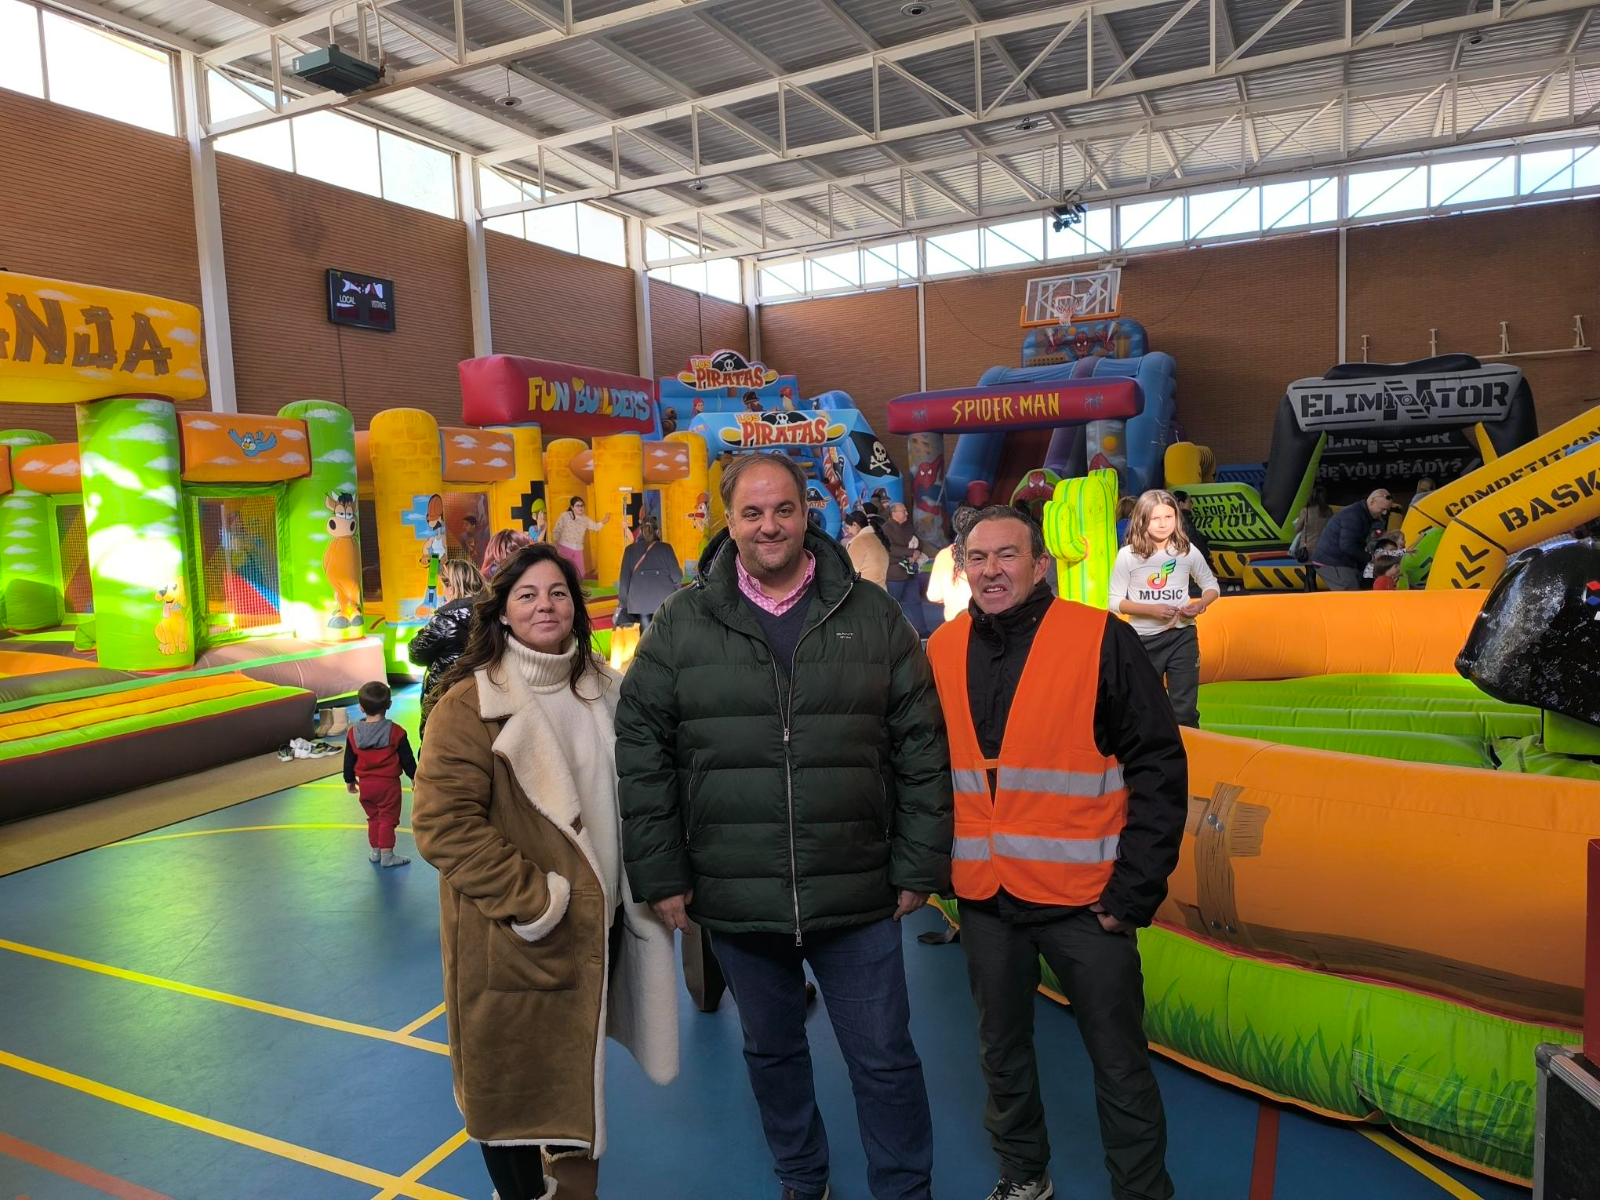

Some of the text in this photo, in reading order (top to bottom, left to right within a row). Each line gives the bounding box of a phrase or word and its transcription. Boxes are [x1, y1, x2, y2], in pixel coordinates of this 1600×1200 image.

[339, 294, 356, 304] LOCAL
[692, 358, 712, 369] LOS
[696, 366, 764, 389] PIRATAS
[528, 377, 651, 421] FUN BUILDERS
[737, 414, 760, 424] LOS
[741, 418, 828, 447] PIRATAS
[1318, 458, 1462, 480] RE YOU READY?
[1499, 467, 1600, 533] BASK
[1202, 504, 1227, 516] FOR
[1218, 513, 1257, 528] YOU
[1139, 589, 1183, 601] MUSIC
